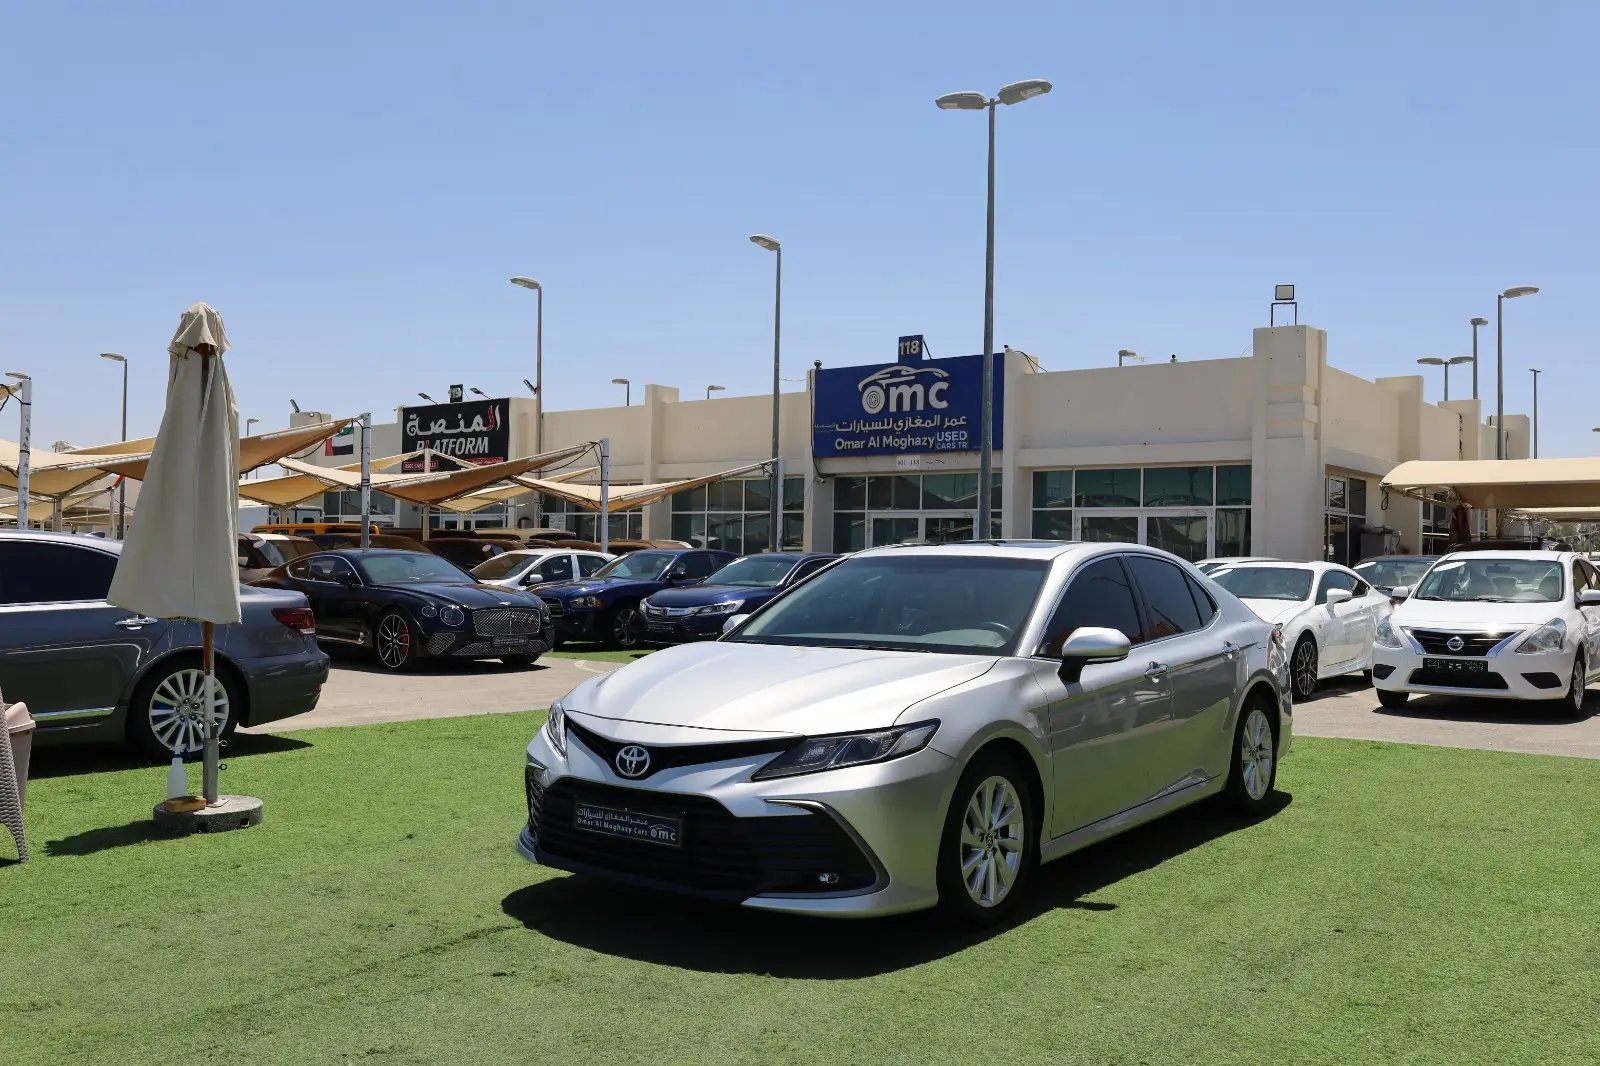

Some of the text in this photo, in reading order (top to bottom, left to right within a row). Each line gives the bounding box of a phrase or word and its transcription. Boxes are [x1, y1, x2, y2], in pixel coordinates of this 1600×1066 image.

[899, 340, 920, 356] 118
[406, 404, 500, 436] المنصة
[835, 414, 967, 434] عمر المغازي للسيارات
[835, 434, 935, 450] Omar Al Moghazy
[936, 430, 968, 442] USED
[935, 442, 956, 450] CARS
[957, 441, 968, 449] TR
[577, 807, 604, 820] للسيارات
[577, 817, 648, 836] Omar Al Moghazy Cars
